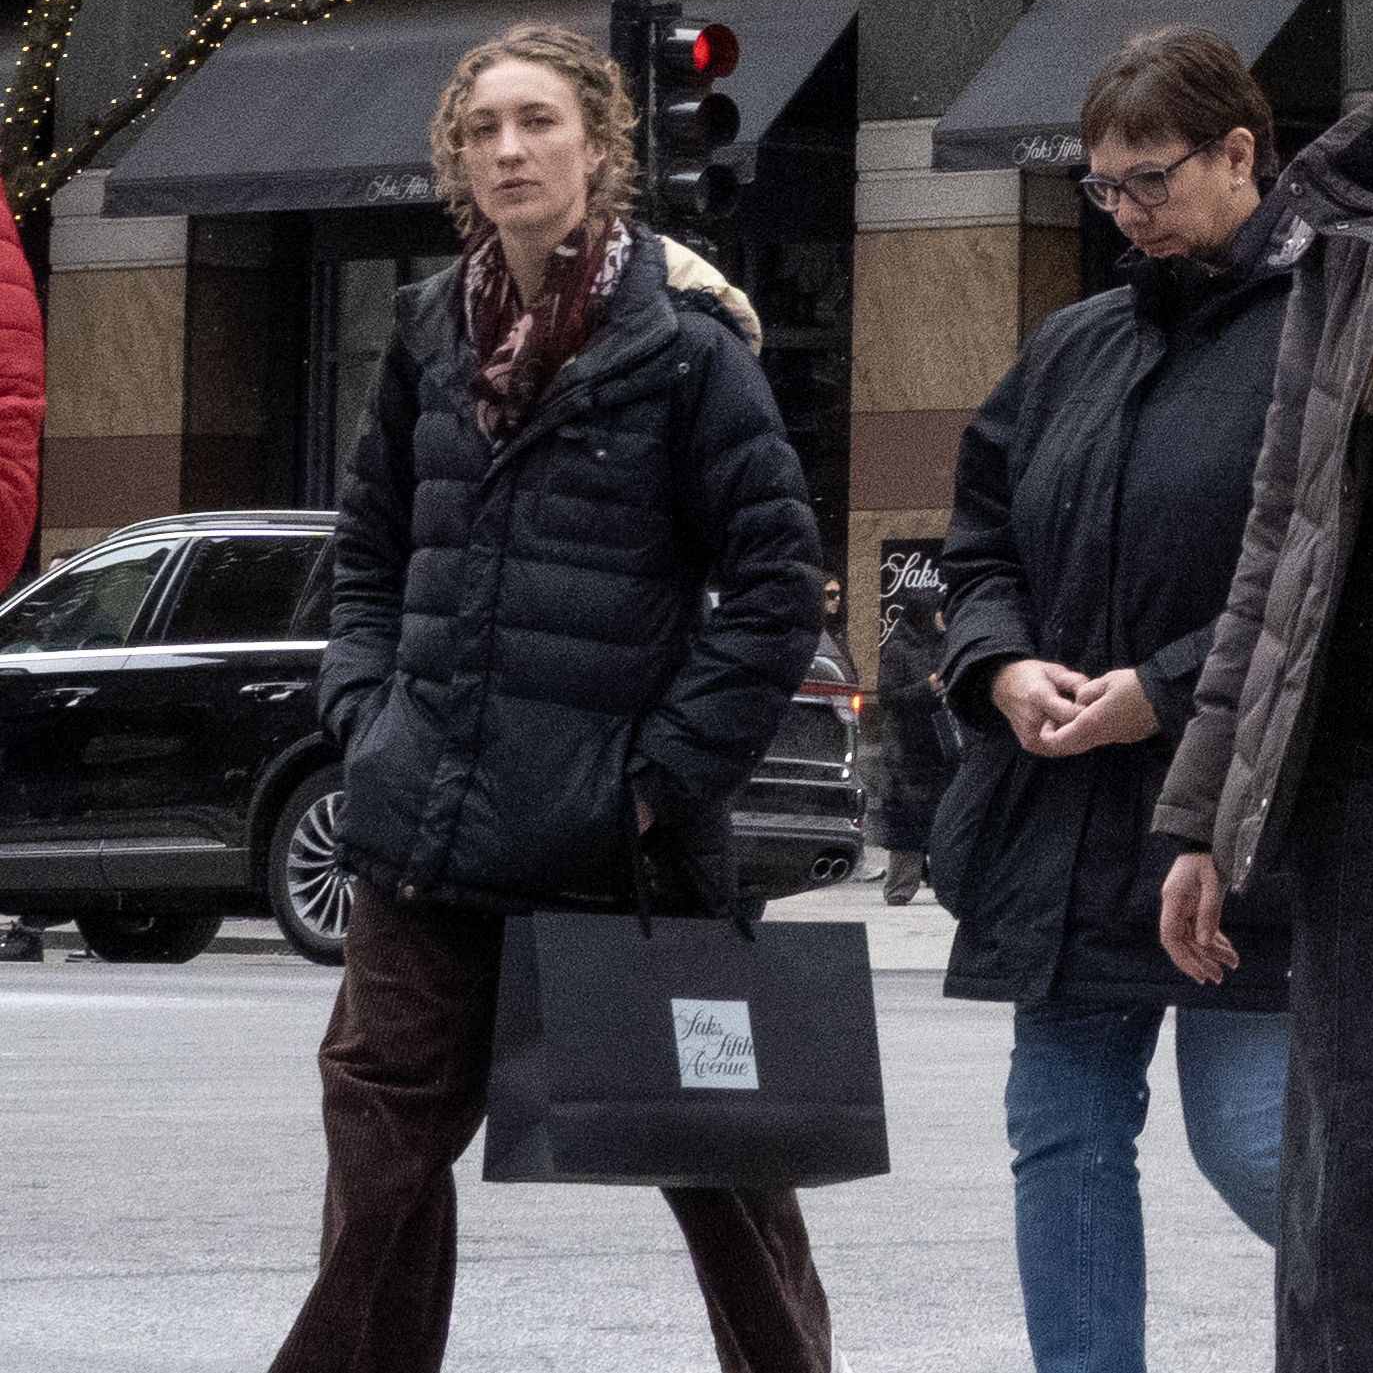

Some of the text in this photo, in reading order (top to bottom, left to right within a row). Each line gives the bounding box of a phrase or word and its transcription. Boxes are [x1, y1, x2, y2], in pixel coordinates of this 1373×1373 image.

[879, 551, 941, 598] Saks
[674, 1008, 723, 1041] Saks
[680, 1046, 750, 1079] Avenue
